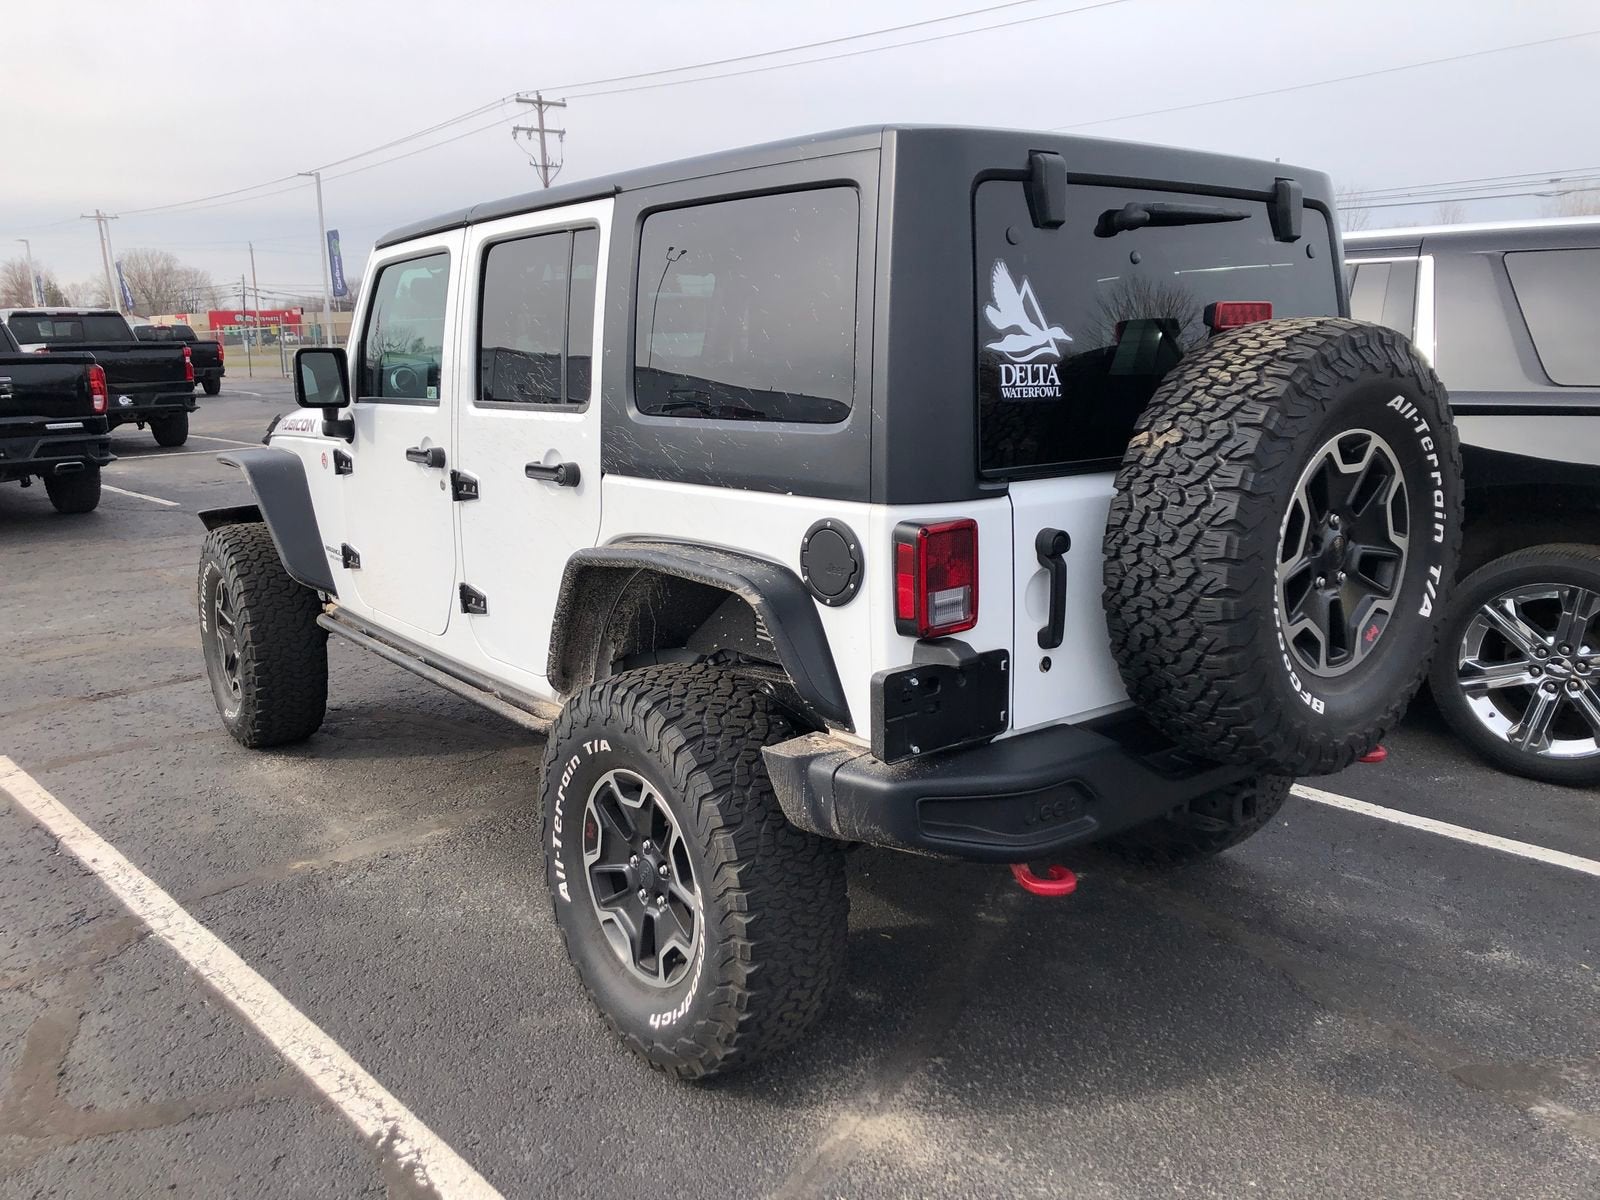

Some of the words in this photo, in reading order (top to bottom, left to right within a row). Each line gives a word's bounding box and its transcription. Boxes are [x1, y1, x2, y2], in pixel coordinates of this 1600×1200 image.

[999, 364, 1062, 387] DELTA
[1001, 386, 1062, 399] WATERFOWL
[1386, 395, 1444, 543] All-Terrain
[1417, 564, 1442, 618] T/A
[552, 754, 581, 903] All-Terrain
[583, 738, 613, 753] T/A
